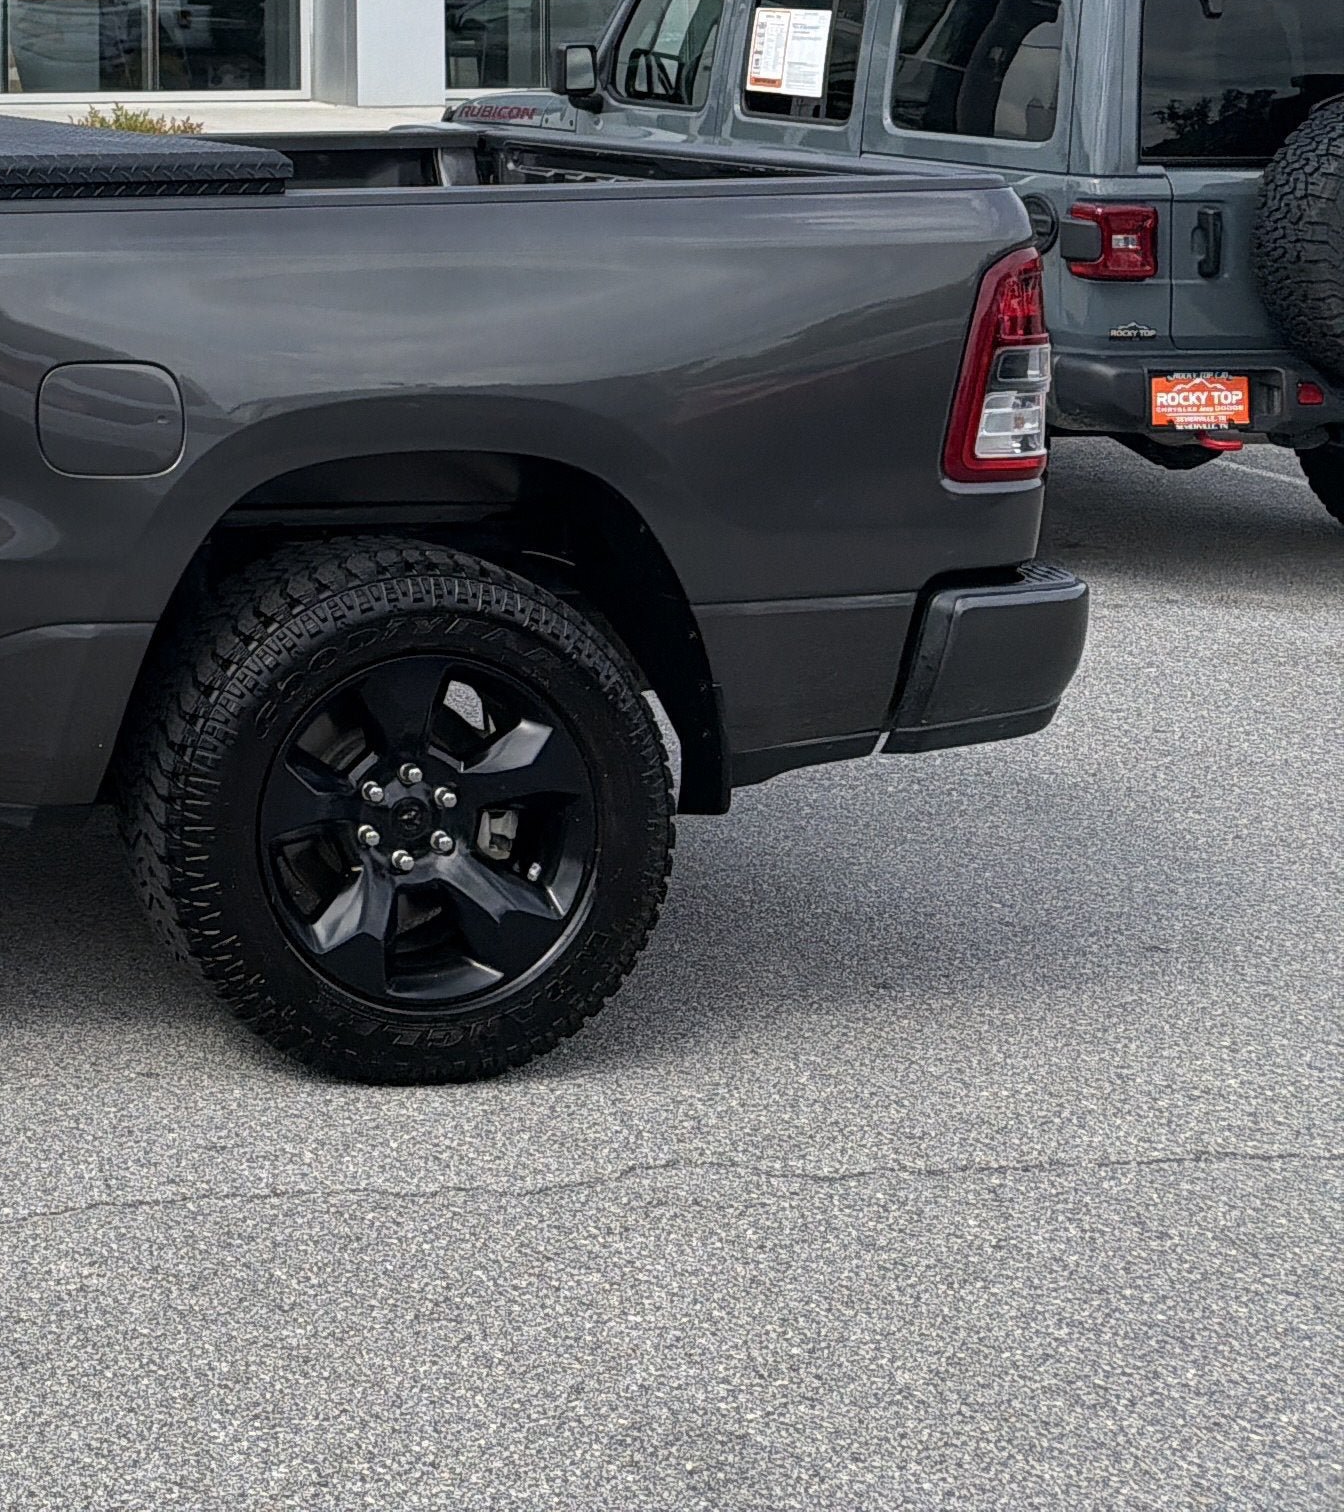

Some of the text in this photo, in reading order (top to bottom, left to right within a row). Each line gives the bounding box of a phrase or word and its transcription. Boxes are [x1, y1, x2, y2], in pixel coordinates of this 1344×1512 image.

[459, 105, 537, 120] RUBICON
[1110, 329, 1157, 337] ROCKY TOP
[1156, 390, 1243, 406] ROCKY TOP
